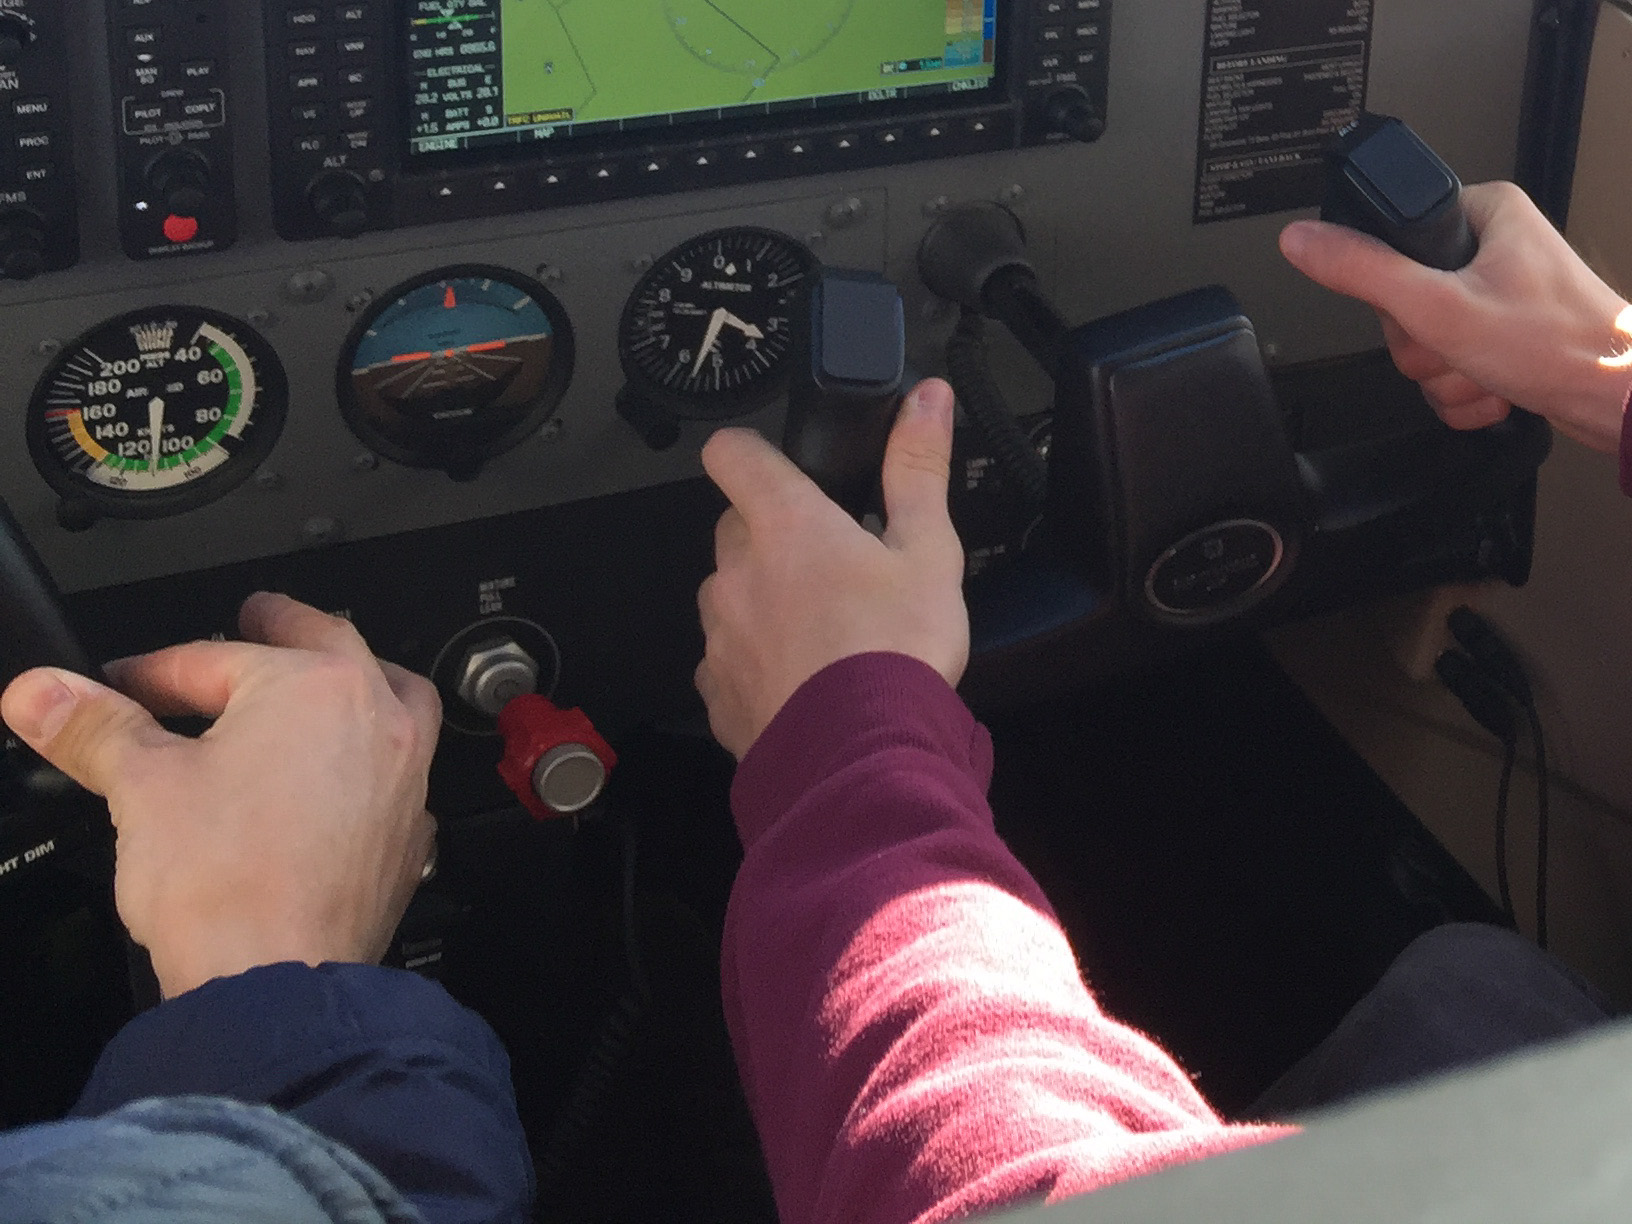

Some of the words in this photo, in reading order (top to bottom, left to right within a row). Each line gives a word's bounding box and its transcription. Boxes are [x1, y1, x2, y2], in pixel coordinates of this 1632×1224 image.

[186, 66, 211, 77] PLAY
[16, 102, 48, 114] MENU
[134, 107, 162, 118] PILOT
[19, 135, 49, 147] PROC
[323, 155, 347, 168] ALT
[26, 168, 46, 180] ENT
[713, 255, 725, 269] 0
[680, 267, 693, 283] 9
[767, 272, 778, 288] 2
[658, 288, 671, 303] 8
[174, 346, 202, 362] 40
[678, 349, 691, 364] 6
[99, 359, 140, 377] 200
[196, 369, 223, 385] 60
[87, 378, 121, 397] 180
[82, 403, 116, 421] 160
[195, 407, 222, 423] 80
[95, 422, 129, 439] 140
[118, 440, 151, 457] 120
[162, 436, 195, 453] 100
[24, 840, 55, 863] DIM
